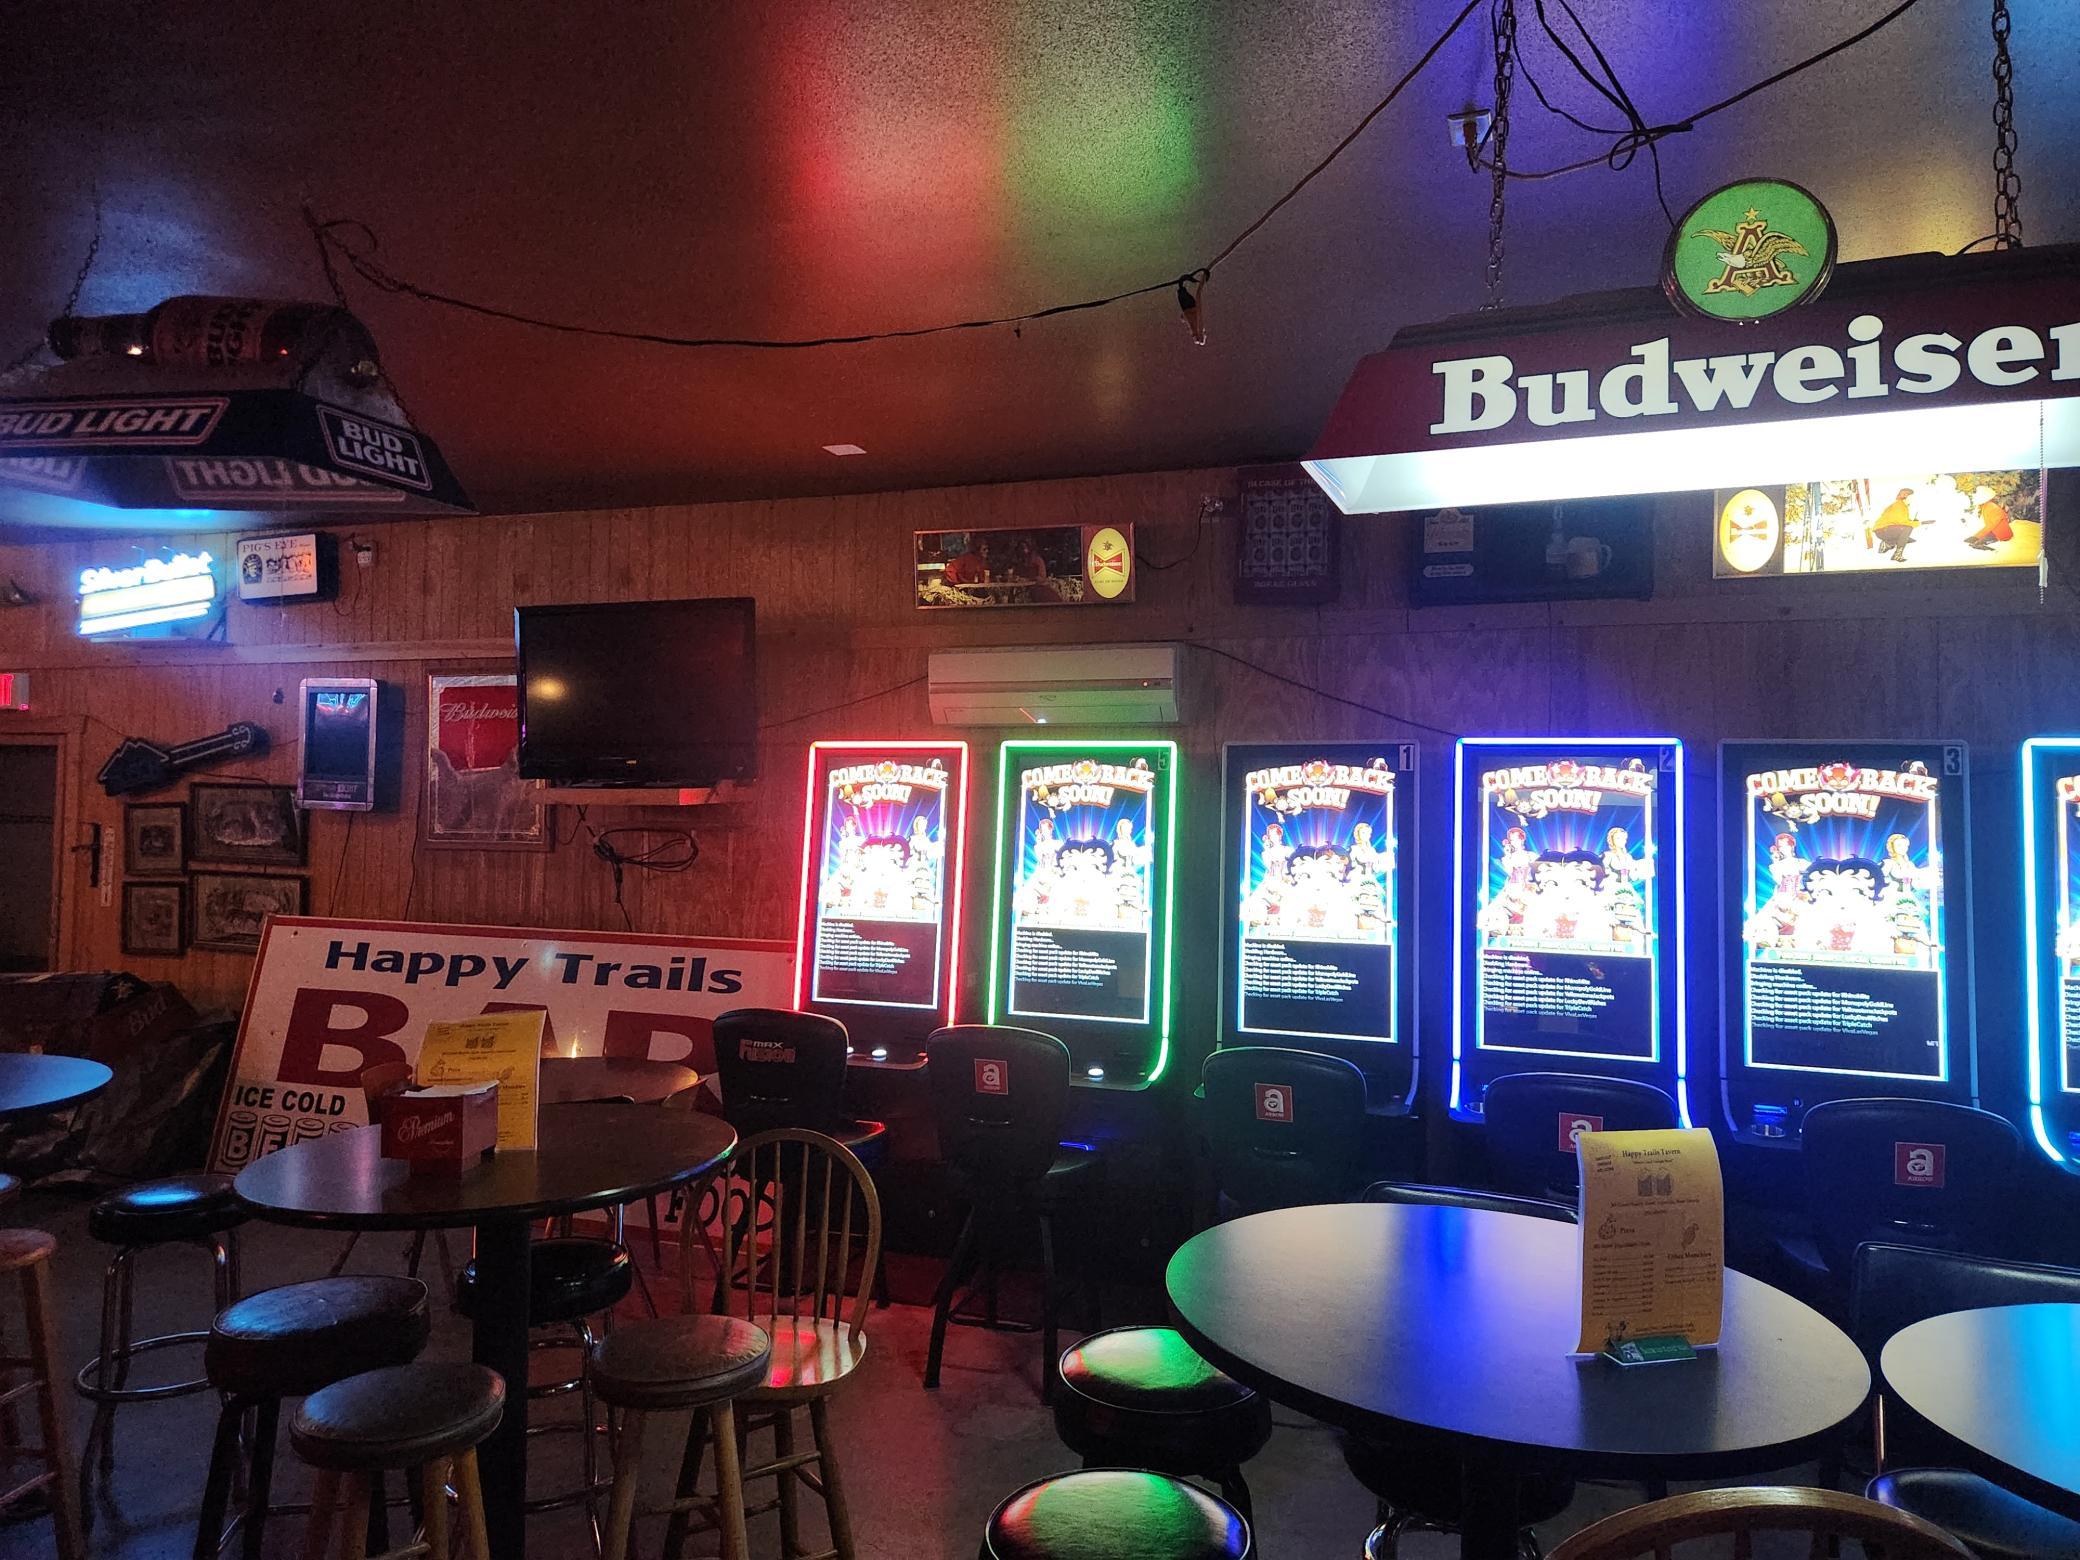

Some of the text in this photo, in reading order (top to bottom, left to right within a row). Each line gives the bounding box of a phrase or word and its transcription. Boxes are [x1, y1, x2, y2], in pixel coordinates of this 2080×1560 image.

[74, 407, 211, 434] LIGHT
[341, 419, 403, 453] BUD
[337, 434, 419, 476] LIGHT
[242, 543, 272, 553] PIG'S
[274, 539, 297, 549] EYE
[1403, 747, 1412, 770] 1
[1947, 748, 1960, 773] 3
[830, 764, 949, 786] COME BACK
[1022, 764, 1155, 788] COME BACK
[1245, 765, 1396, 790] COME BACK
[1482, 767, 1655, 794] COME BACK
[1747, 769, 1937, 797] COME BACK
[862, 784, 912, 802] SOON!
[1060, 787, 1114, 805] SOON!
[1288, 788, 1350, 809] SOON!
[1532, 790, 1602, 812] SOON!
[1802, 793, 1880, 817] SOON!
[323, 940, 743, 994] Happy Trails
[234, 1085, 347, 1116] ICE COLD
[397, 1110, 455, 1143] Premium
[1622, 1150, 1641, 1158] Happy
[1661, 1148, 1681, 1156] Tavern
[1906, 1148, 1934, 1176] a
